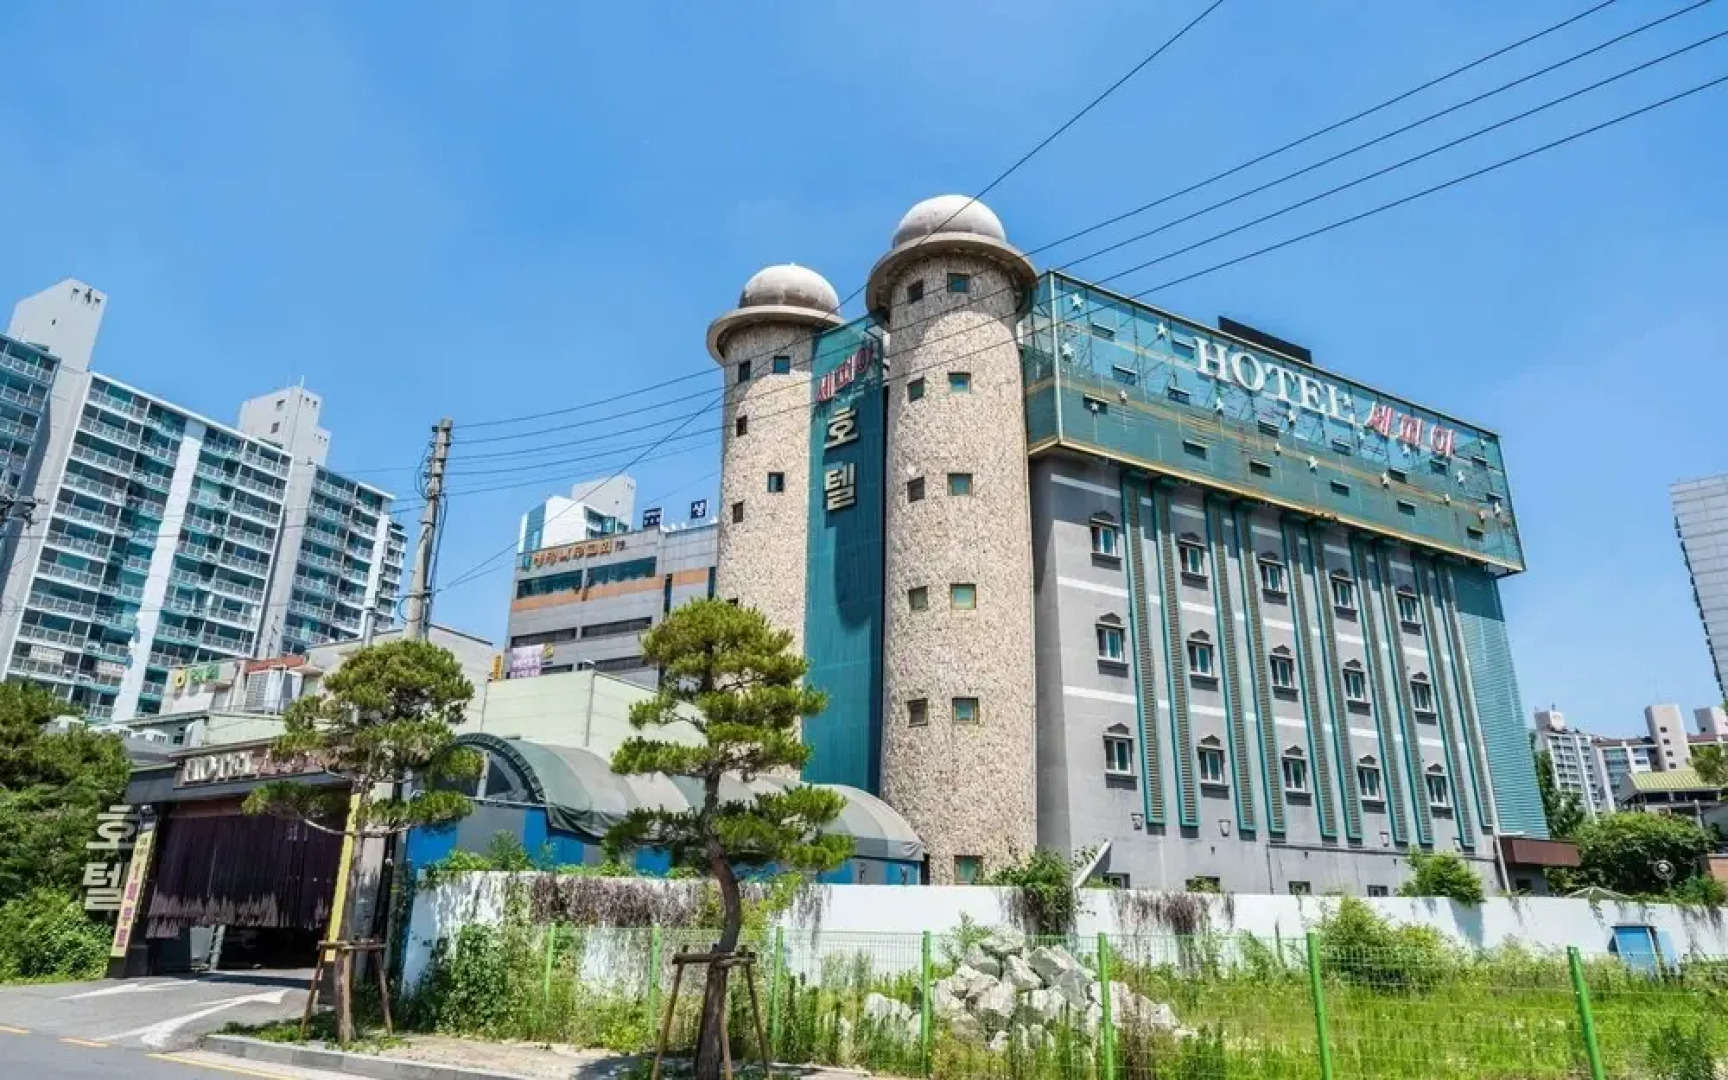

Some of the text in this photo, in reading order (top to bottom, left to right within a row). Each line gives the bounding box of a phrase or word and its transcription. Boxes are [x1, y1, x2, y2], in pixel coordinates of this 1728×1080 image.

[1194, 335, 1355, 425] HOTEL
[824, 406, 860, 511] 호텔
[82, 804, 138, 911] 호텔
